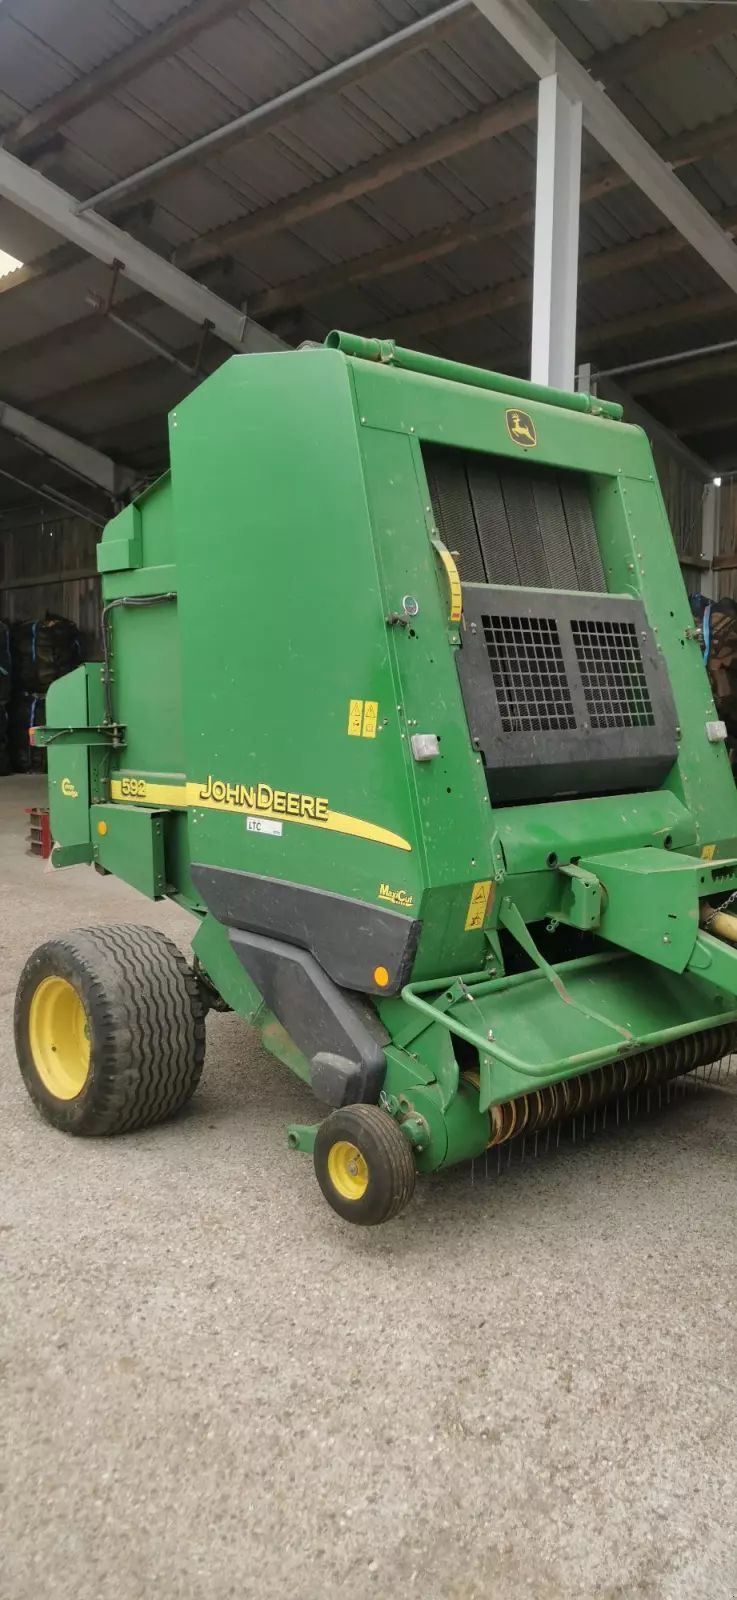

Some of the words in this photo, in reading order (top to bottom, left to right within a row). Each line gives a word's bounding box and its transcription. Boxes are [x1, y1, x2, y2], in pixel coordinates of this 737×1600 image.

[121, 778, 146, 797] 592
[200, 774, 255, 807] JOHN
[256, 783, 329, 821] DEERE
[248, 820, 262, 831] LTC
